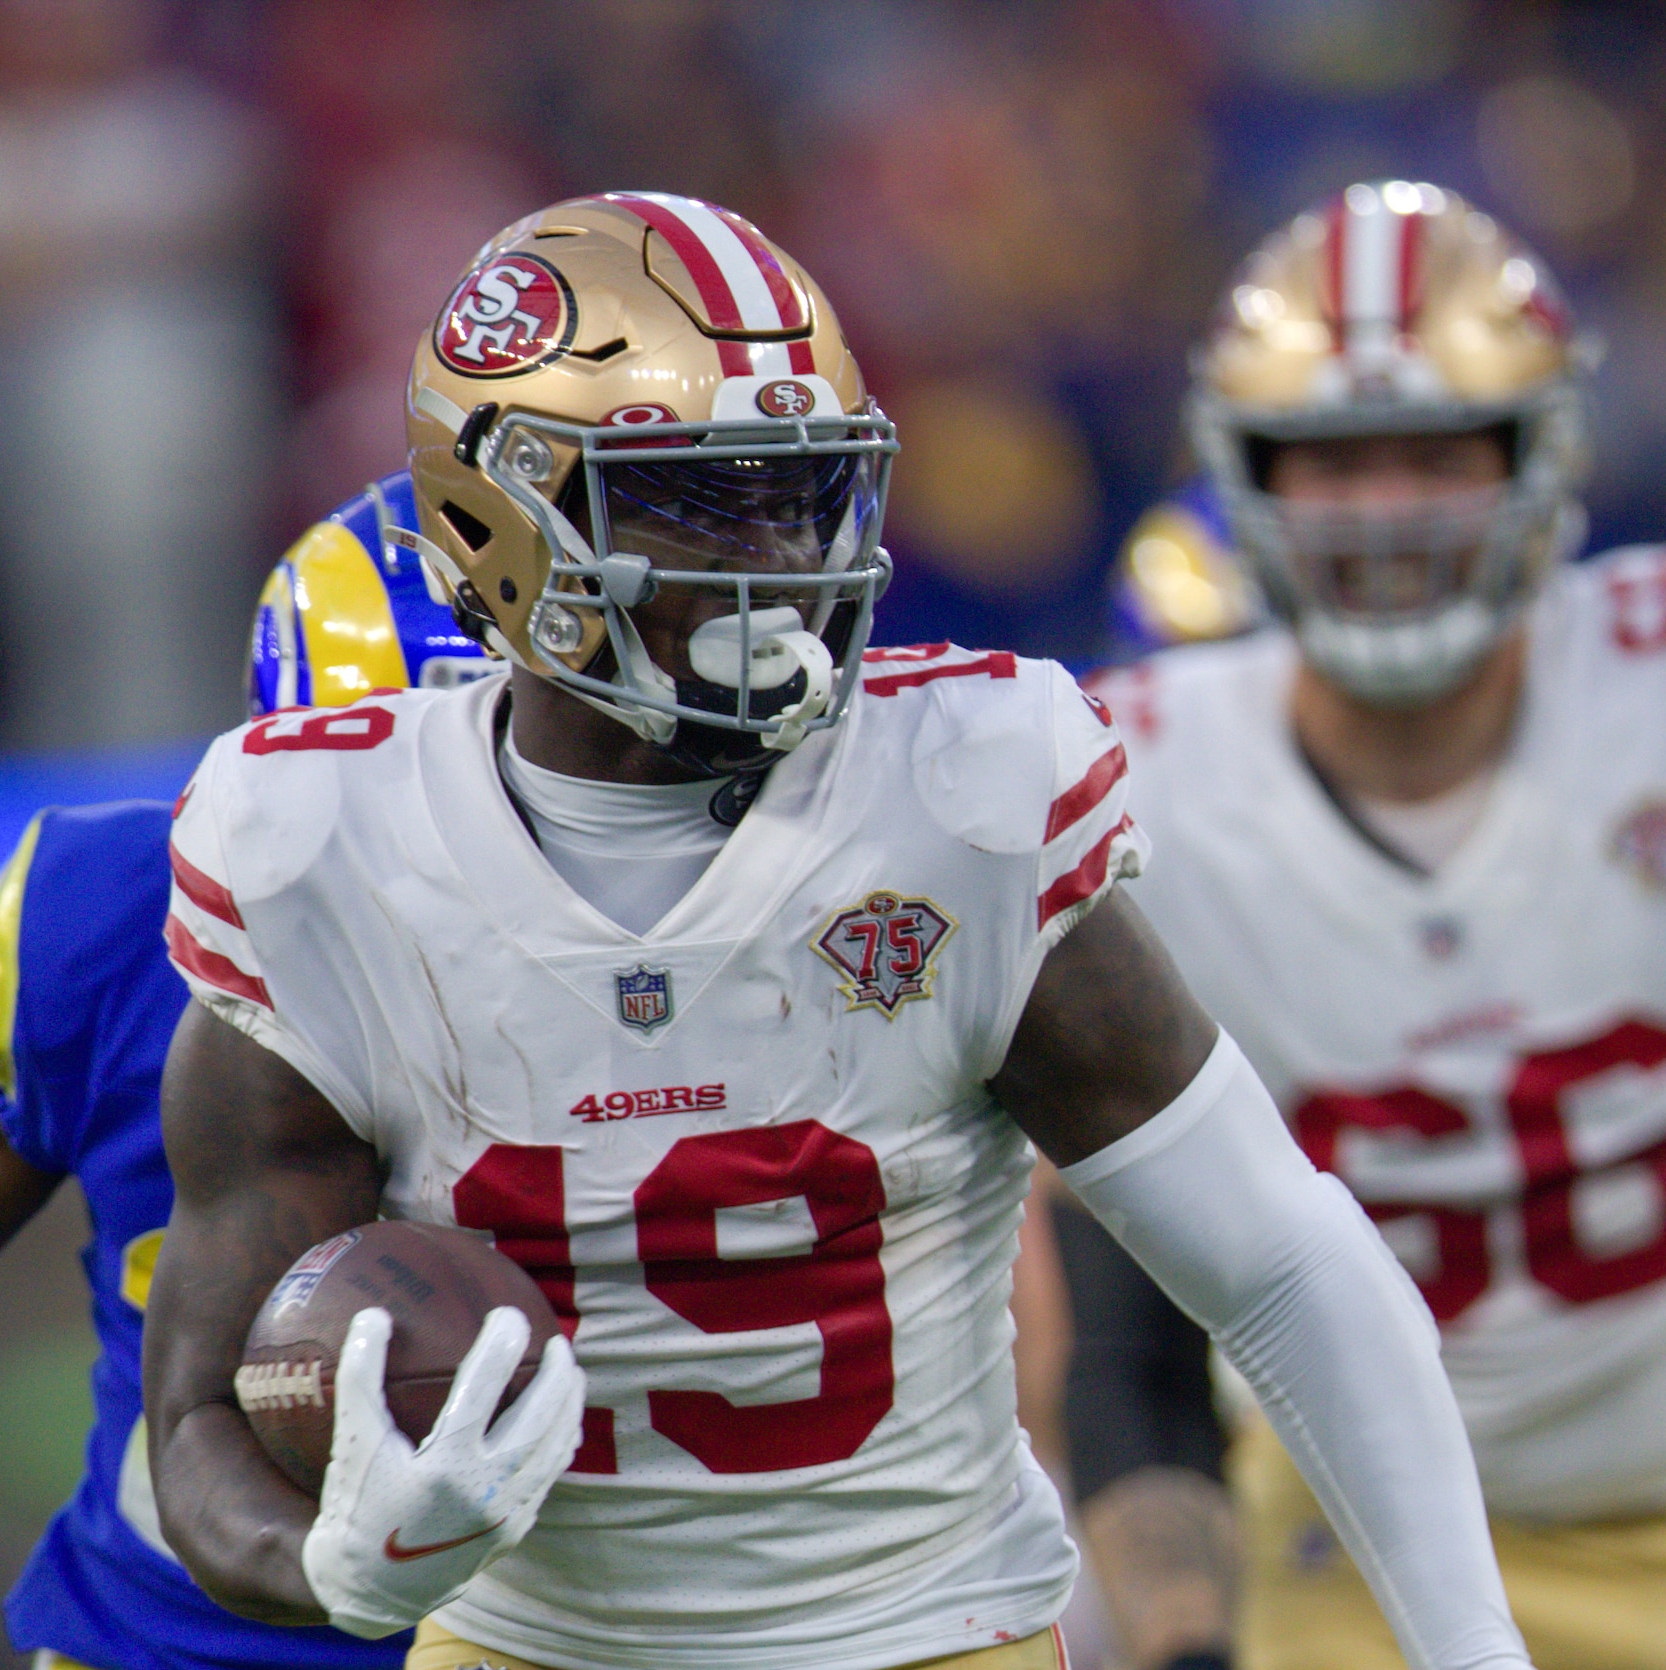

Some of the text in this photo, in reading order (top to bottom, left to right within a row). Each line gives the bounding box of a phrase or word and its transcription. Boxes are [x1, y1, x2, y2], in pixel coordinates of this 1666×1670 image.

[453, 264, 542, 364] SF
[774, 384, 808, 415] SF
[400, 532, 417, 548] 19
[844, 914, 923, 982] 75
[625, 994, 665, 1020] NFL
[569, 1082, 727, 1123] 49ERS
[452, 1118, 895, 1474] 19
